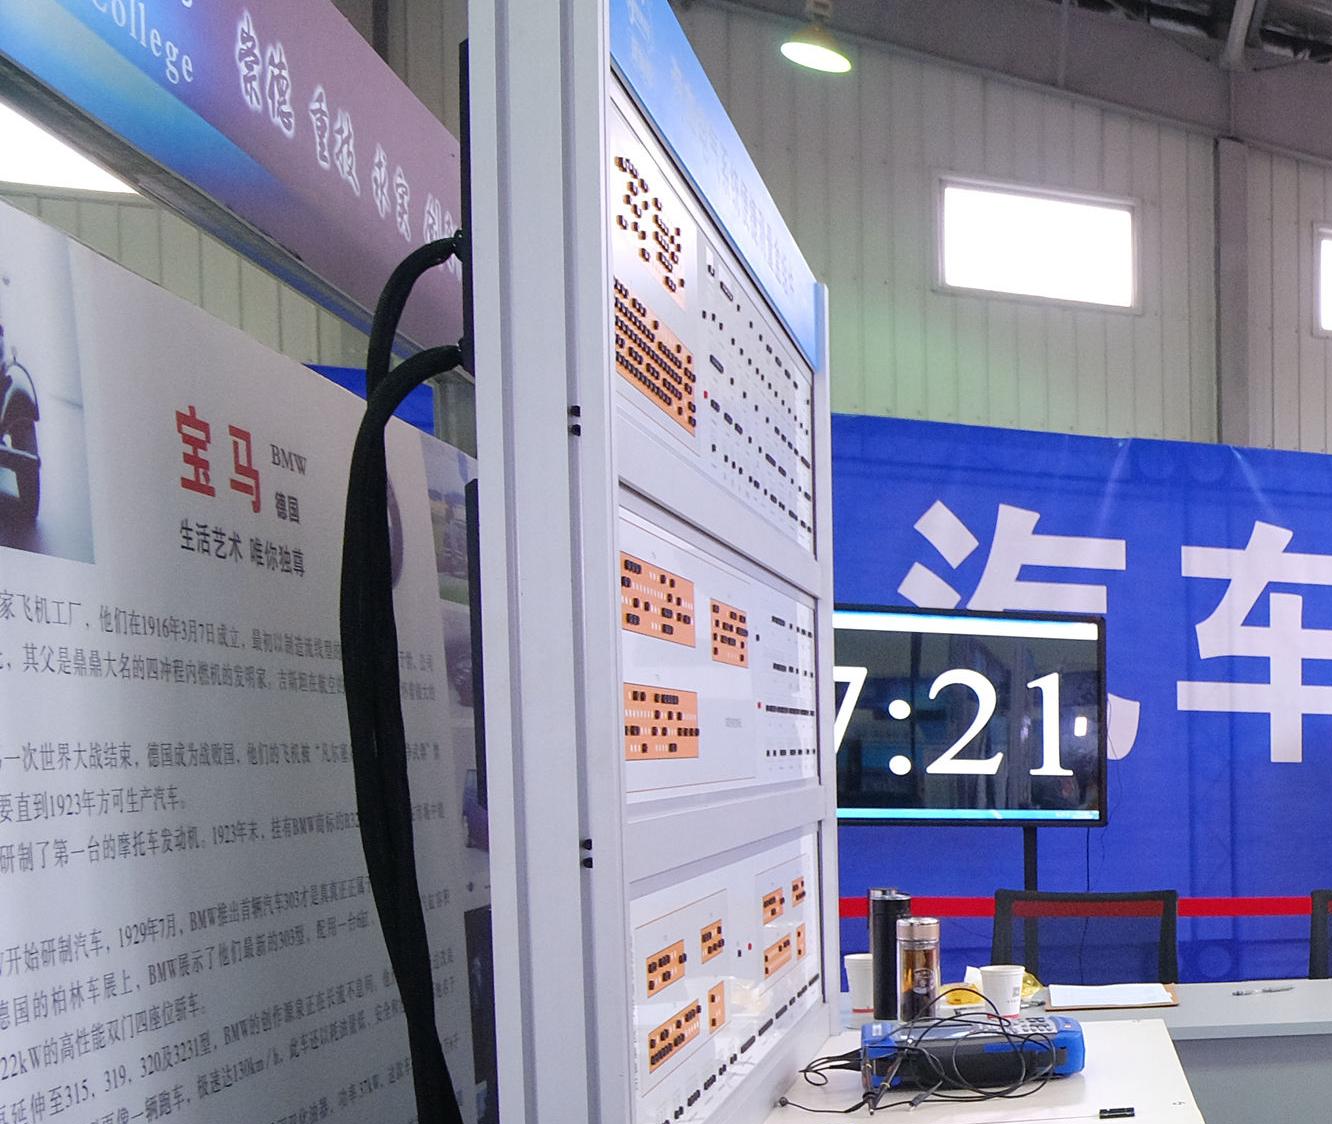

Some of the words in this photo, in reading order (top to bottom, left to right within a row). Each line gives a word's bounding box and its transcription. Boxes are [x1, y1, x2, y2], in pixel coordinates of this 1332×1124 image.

[93, 0, 193, 84] ollege
[176, 405, 260, 513] 宝马
[270, 443, 307, 476] BMW
[180, 518, 243, 563] 生活艺术
[250, 537, 305, 577] 唯你独尊
